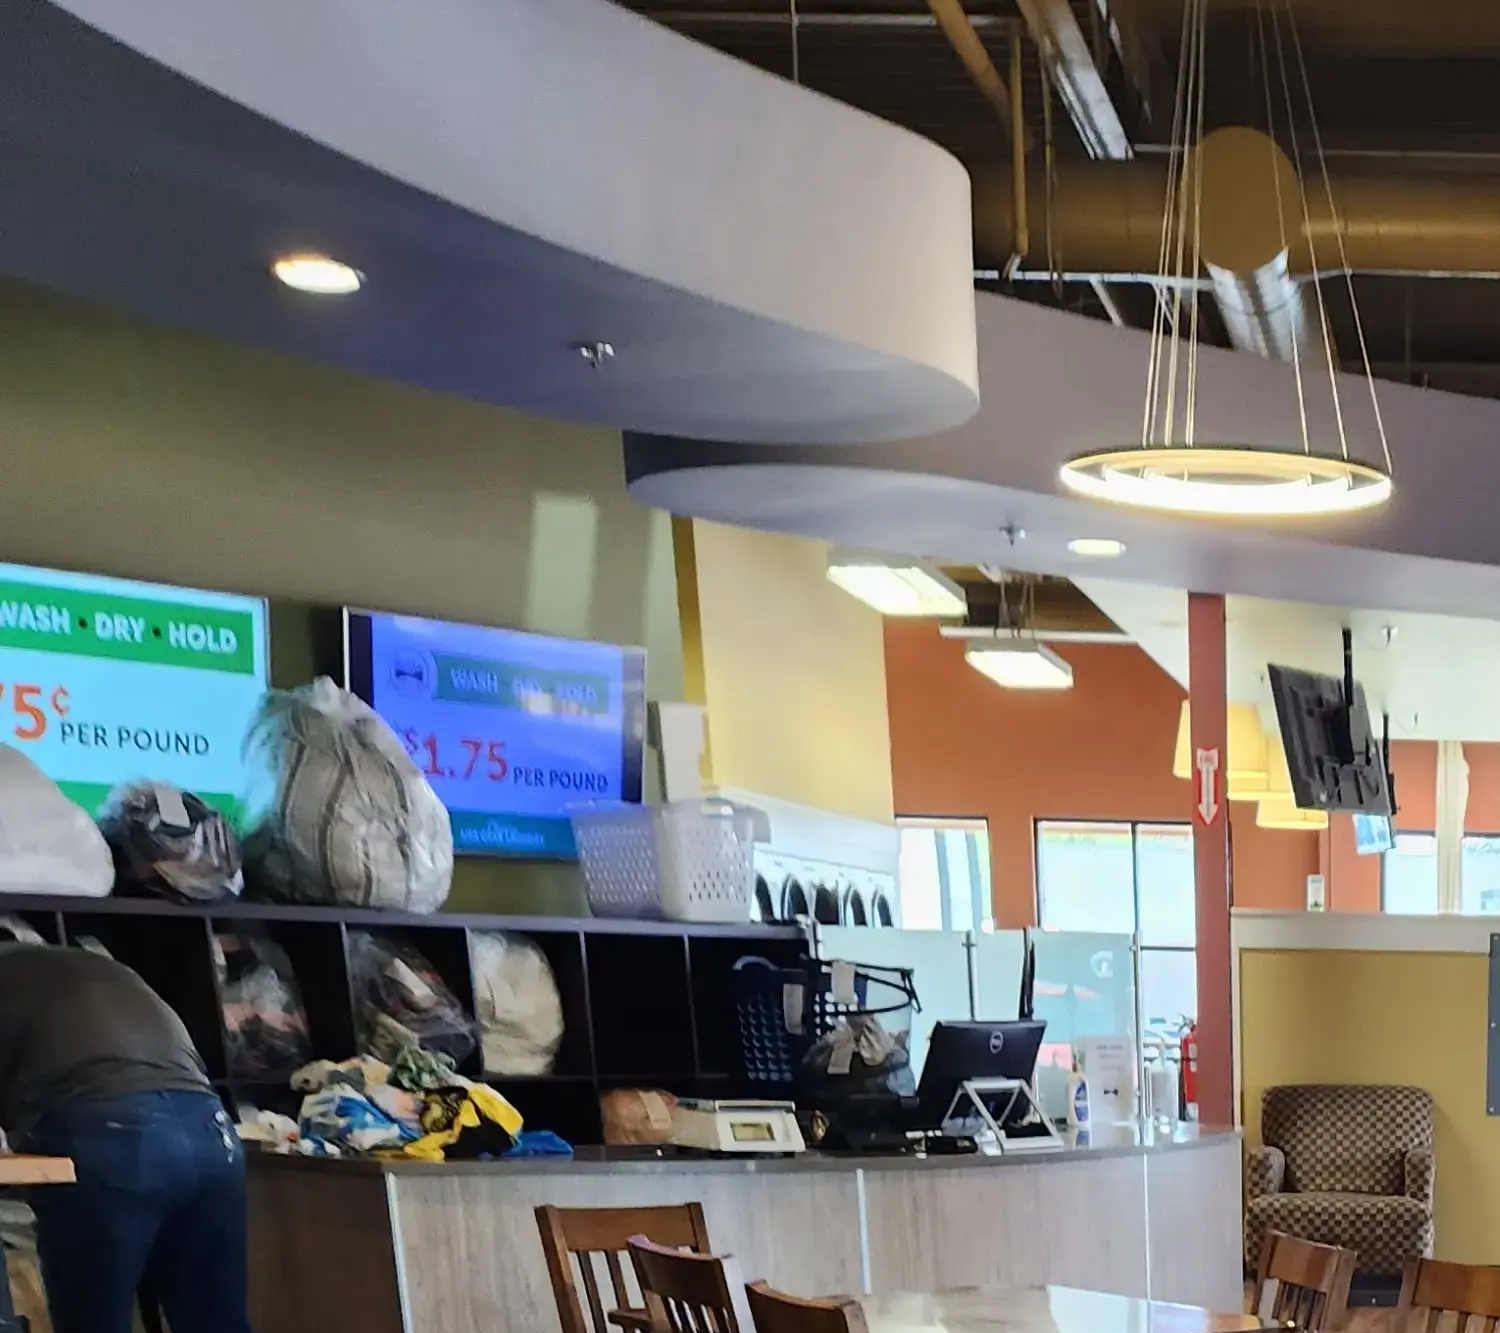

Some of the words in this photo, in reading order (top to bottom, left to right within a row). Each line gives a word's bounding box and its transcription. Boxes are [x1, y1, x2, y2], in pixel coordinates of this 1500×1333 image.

[0, 599, 71, 635] WASH
[94, 611, 145, 643] DRY
[168, 620, 238, 654] HOLD
[0, 684, 70, 740] 5¢
[60, 722, 109, 749] PER
[118, 725, 210, 756] POUND
[513, 767, 544, 787] PER
[550, 772, 608, 792] POUND
